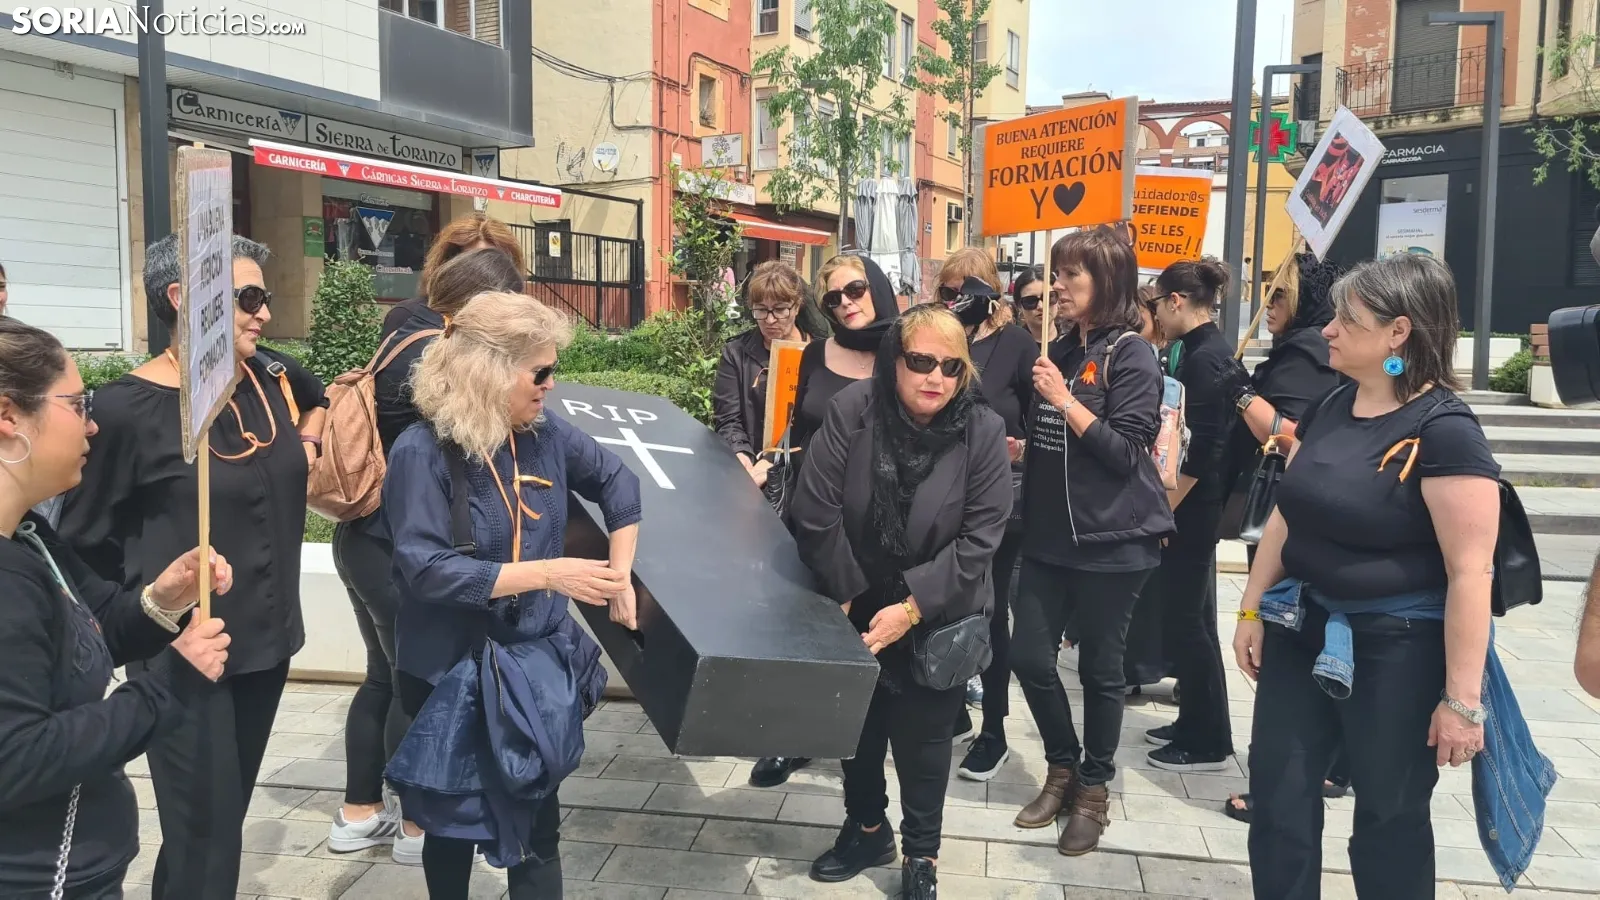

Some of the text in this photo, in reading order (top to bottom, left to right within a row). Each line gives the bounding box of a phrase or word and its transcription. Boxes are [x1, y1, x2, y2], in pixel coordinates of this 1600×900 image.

[996, 109, 1118, 146] BUENA ATENCIÓN
[1020, 137, 1085, 160] REQUIERE
[1382, 144, 1446, 158] FARMACIA
[268, 153, 328, 173] CARNICERÍA
[988, 146, 1124, 188] FORMACIÓN
[1381, 156, 1422, 165] CARRASCOSA
[510, 191, 556, 206] CHARCUTERÍA
[1029, 186, 1050, 220] Y
[1133, 187, 1205, 204] uidador@s
[1132, 203, 1200, 218] DEFIENDE
[1140, 223, 1185, 237] SE LES
[560, 398, 659, 426] RIP
